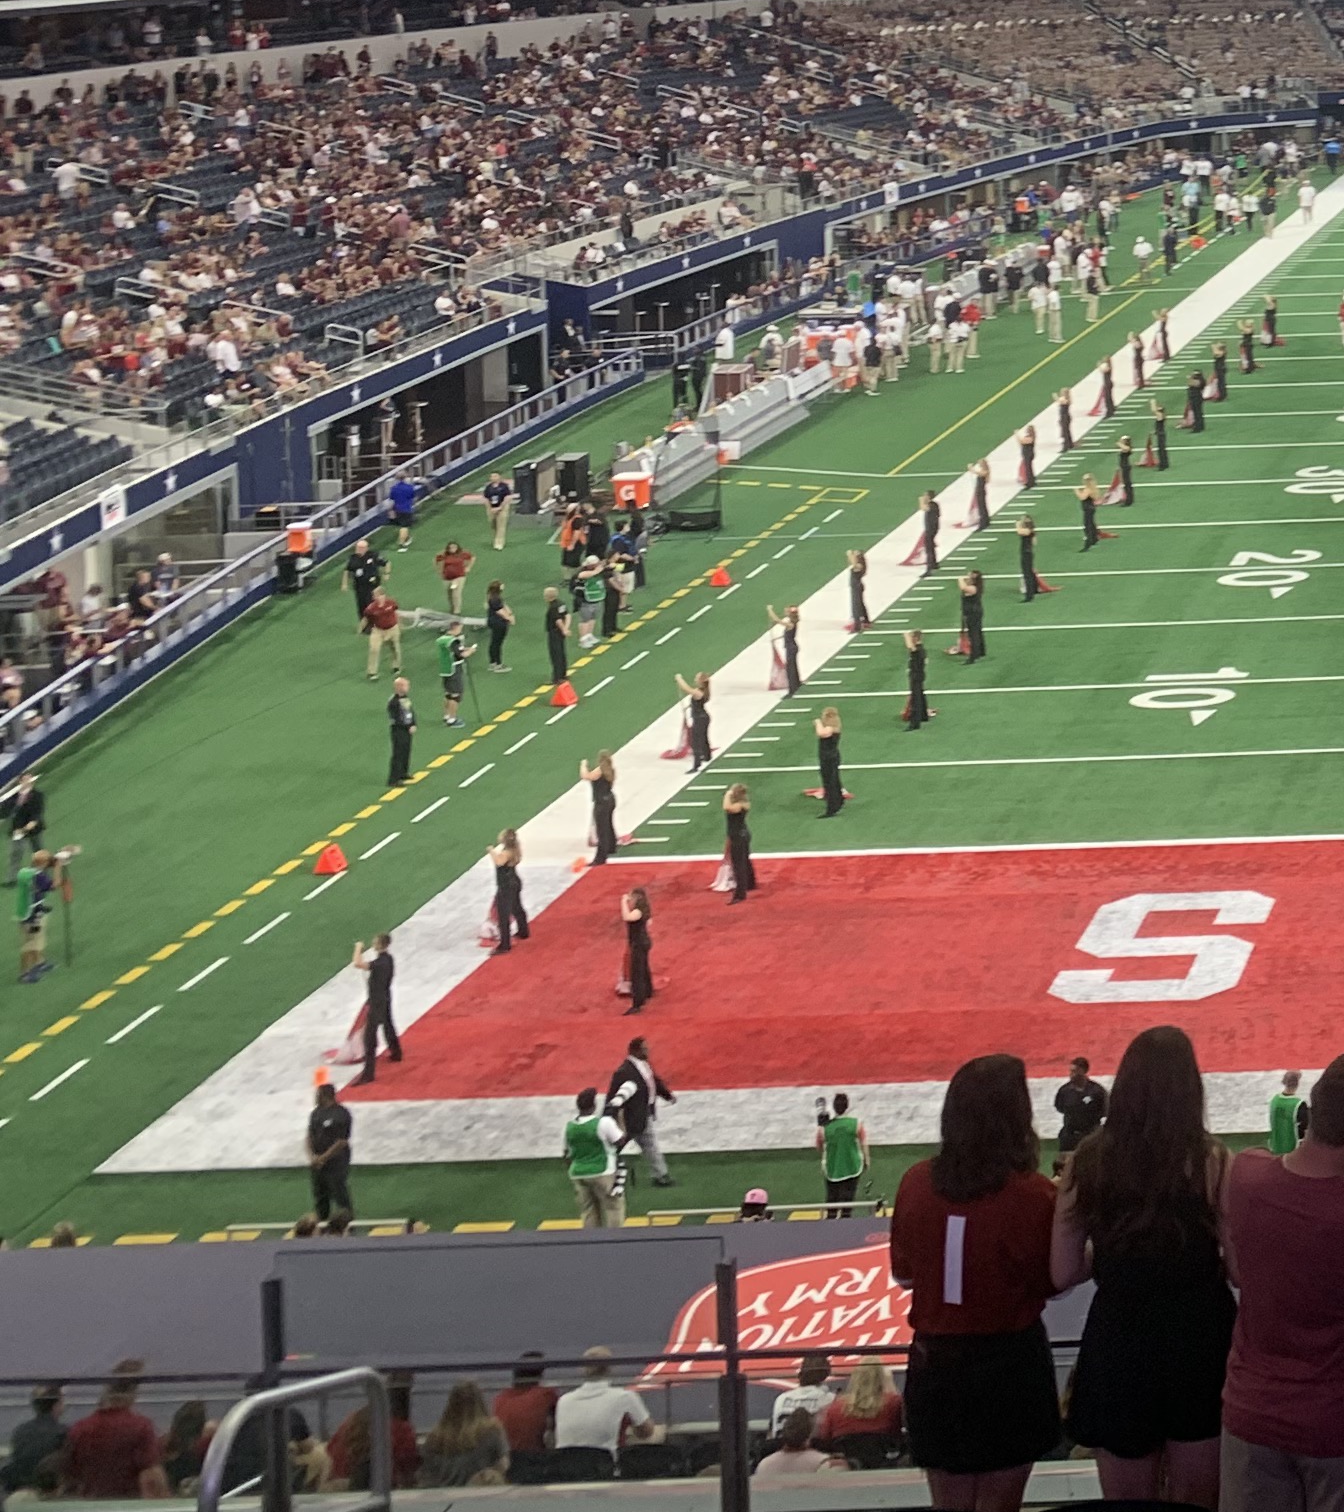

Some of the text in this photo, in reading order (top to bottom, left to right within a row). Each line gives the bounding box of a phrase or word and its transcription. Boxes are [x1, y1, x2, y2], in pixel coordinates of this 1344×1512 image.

[1216, 548, 1323, 588] 20
[1127, 666, 1251, 710] 10
[943, 1215, 967, 1305] 1
